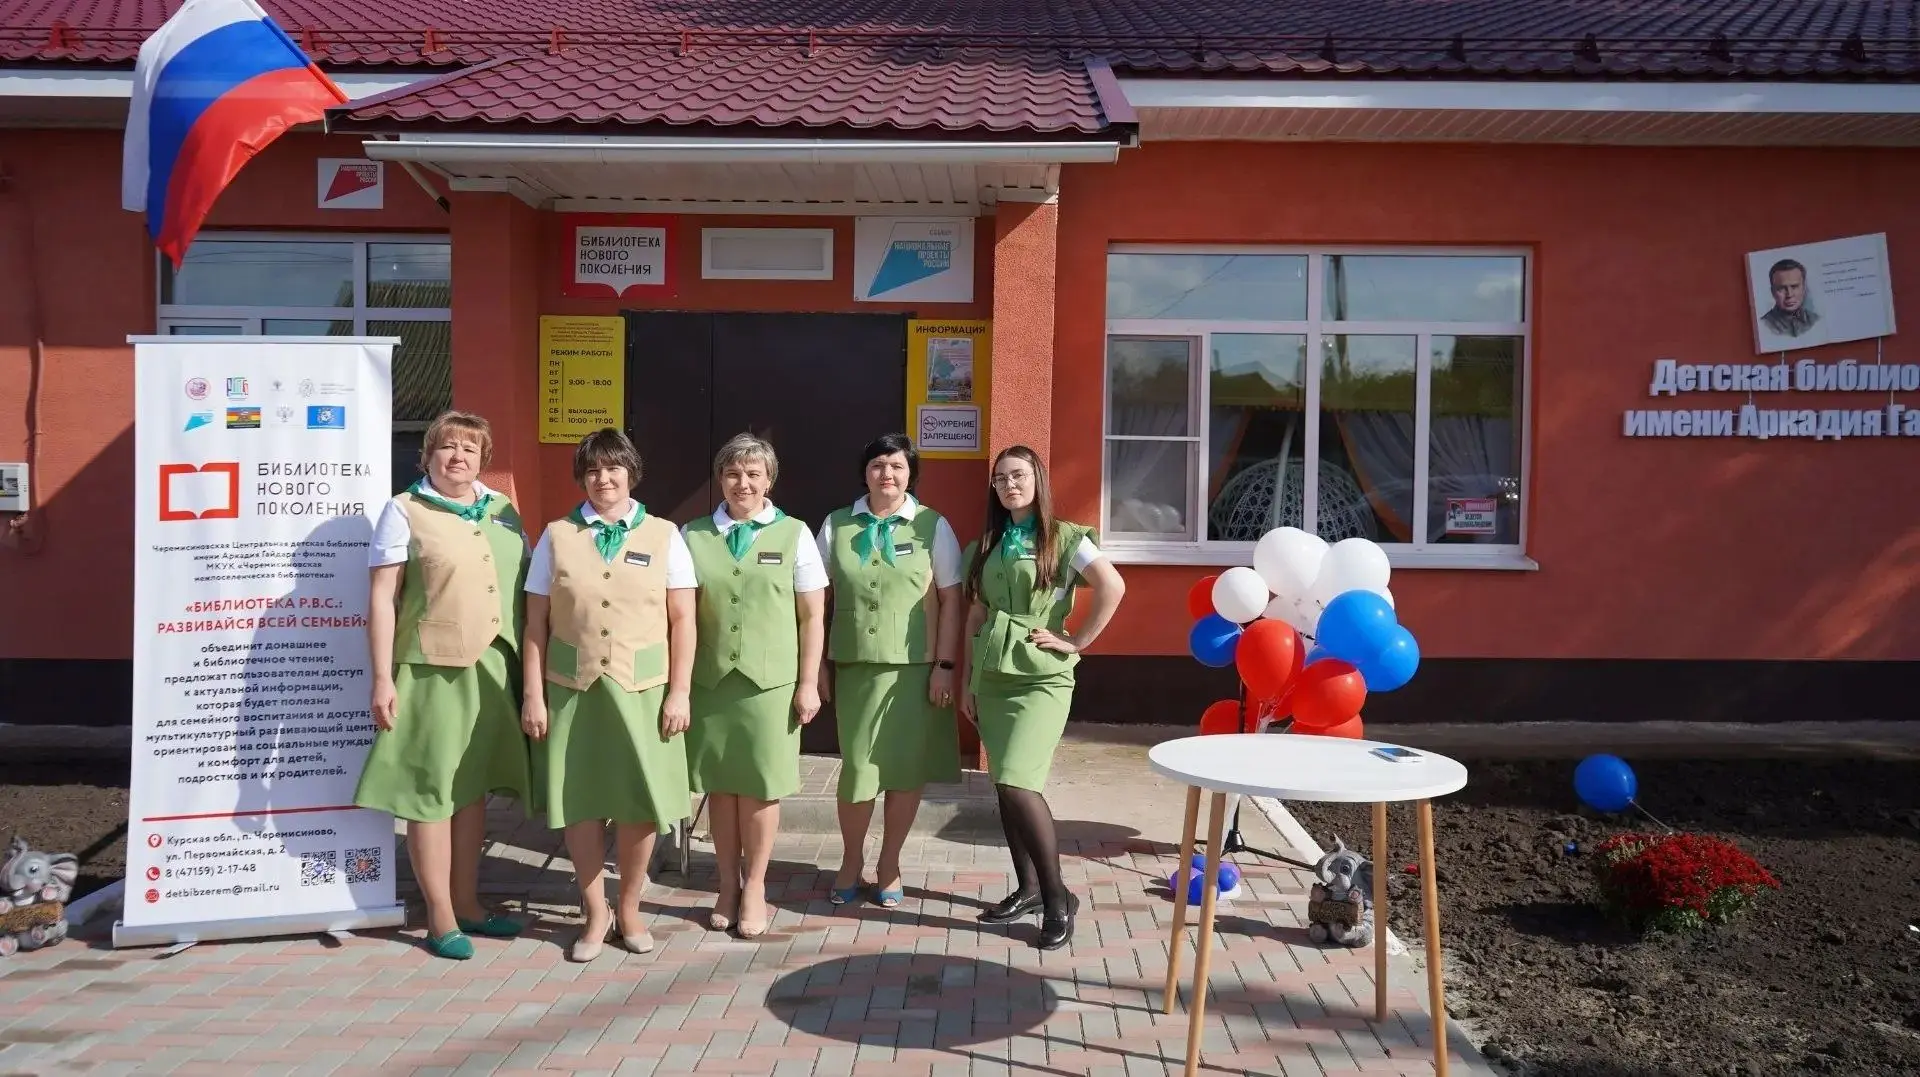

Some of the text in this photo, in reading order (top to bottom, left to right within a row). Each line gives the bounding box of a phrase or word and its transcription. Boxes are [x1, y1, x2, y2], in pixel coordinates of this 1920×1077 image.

[580, 236, 661, 248] БИБЛИОТЕКА
[580, 250, 629, 261] НОВОГО
[580, 263, 651, 275] ПОКОЛЕНИЯ
[915, 325, 986, 335] ИНФОРМАЦИЯ
[581, 349, 613, 357] РАБОТЫ
[592, 379, 612, 387] 18:00
[1649, 358, 1920, 397] Детская библио
[938, 419, 975, 428] КУРЕНИЕ
[1624, 409, 1733, 437] имени
[1738, 404, 1882, 441] Аркадия
[923, 432, 976, 441] ЗАПРЕЩЕНО!
[257, 463, 371, 477] БИБЛИОТЕКА
[257, 482, 331, 496] НОВОГО
[257, 501, 365, 517] ПОКОЛЕНИЯ
[152, 543, 230, 553] Черемисиновская
[232, 540, 288, 549] Центральная
[222, 552, 259, 560] Аркадия
[206, 562, 235, 570] МКУК
[194, 571, 335, 581] межпоселенческая библиотека»
[185, 597, 343, 613] «БИБЛИОТЕКА Р.В.С.:
[157, 616, 254, 634] РАЗВИВАЙСЯ
[258, 614, 297, 629] ВСЕЙ
[201, 641, 327, 653] объединит домашнее
[203, 655, 286, 667] библиотечное
[288, 655, 335, 664] чтение;
[164, 668, 363, 685] предложат пользователям доступ
[184, 682, 343, 697] к актуальной информации,
[196, 697, 330, 711] которая будет полезна
[156, 709, 371, 728] для семейного воспитания и досуга;
[145, 727, 256, 743] мультикультурный
[259, 723, 343, 737] развивающий
[153, 745, 237, 757] ориентирован
[256, 739, 329, 750] социальные
[332, 738, 373, 749] нужды
[198, 752, 326, 768] и комфорт для детей,
[178, 772, 247, 785] подростков
[261, 771, 275, 779] их
[278, 766, 346, 780] родителей.
[167, 836, 210, 847] Курская
[166, 854, 181, 863] ул.
[267, 847, 277, 856] д.
[279, 844, 286, 854] 2
[165, 863, 257, 879] 8 (47159) 2-17-48
[165, 883, 280, 898] detbibzerem@mail.ru
